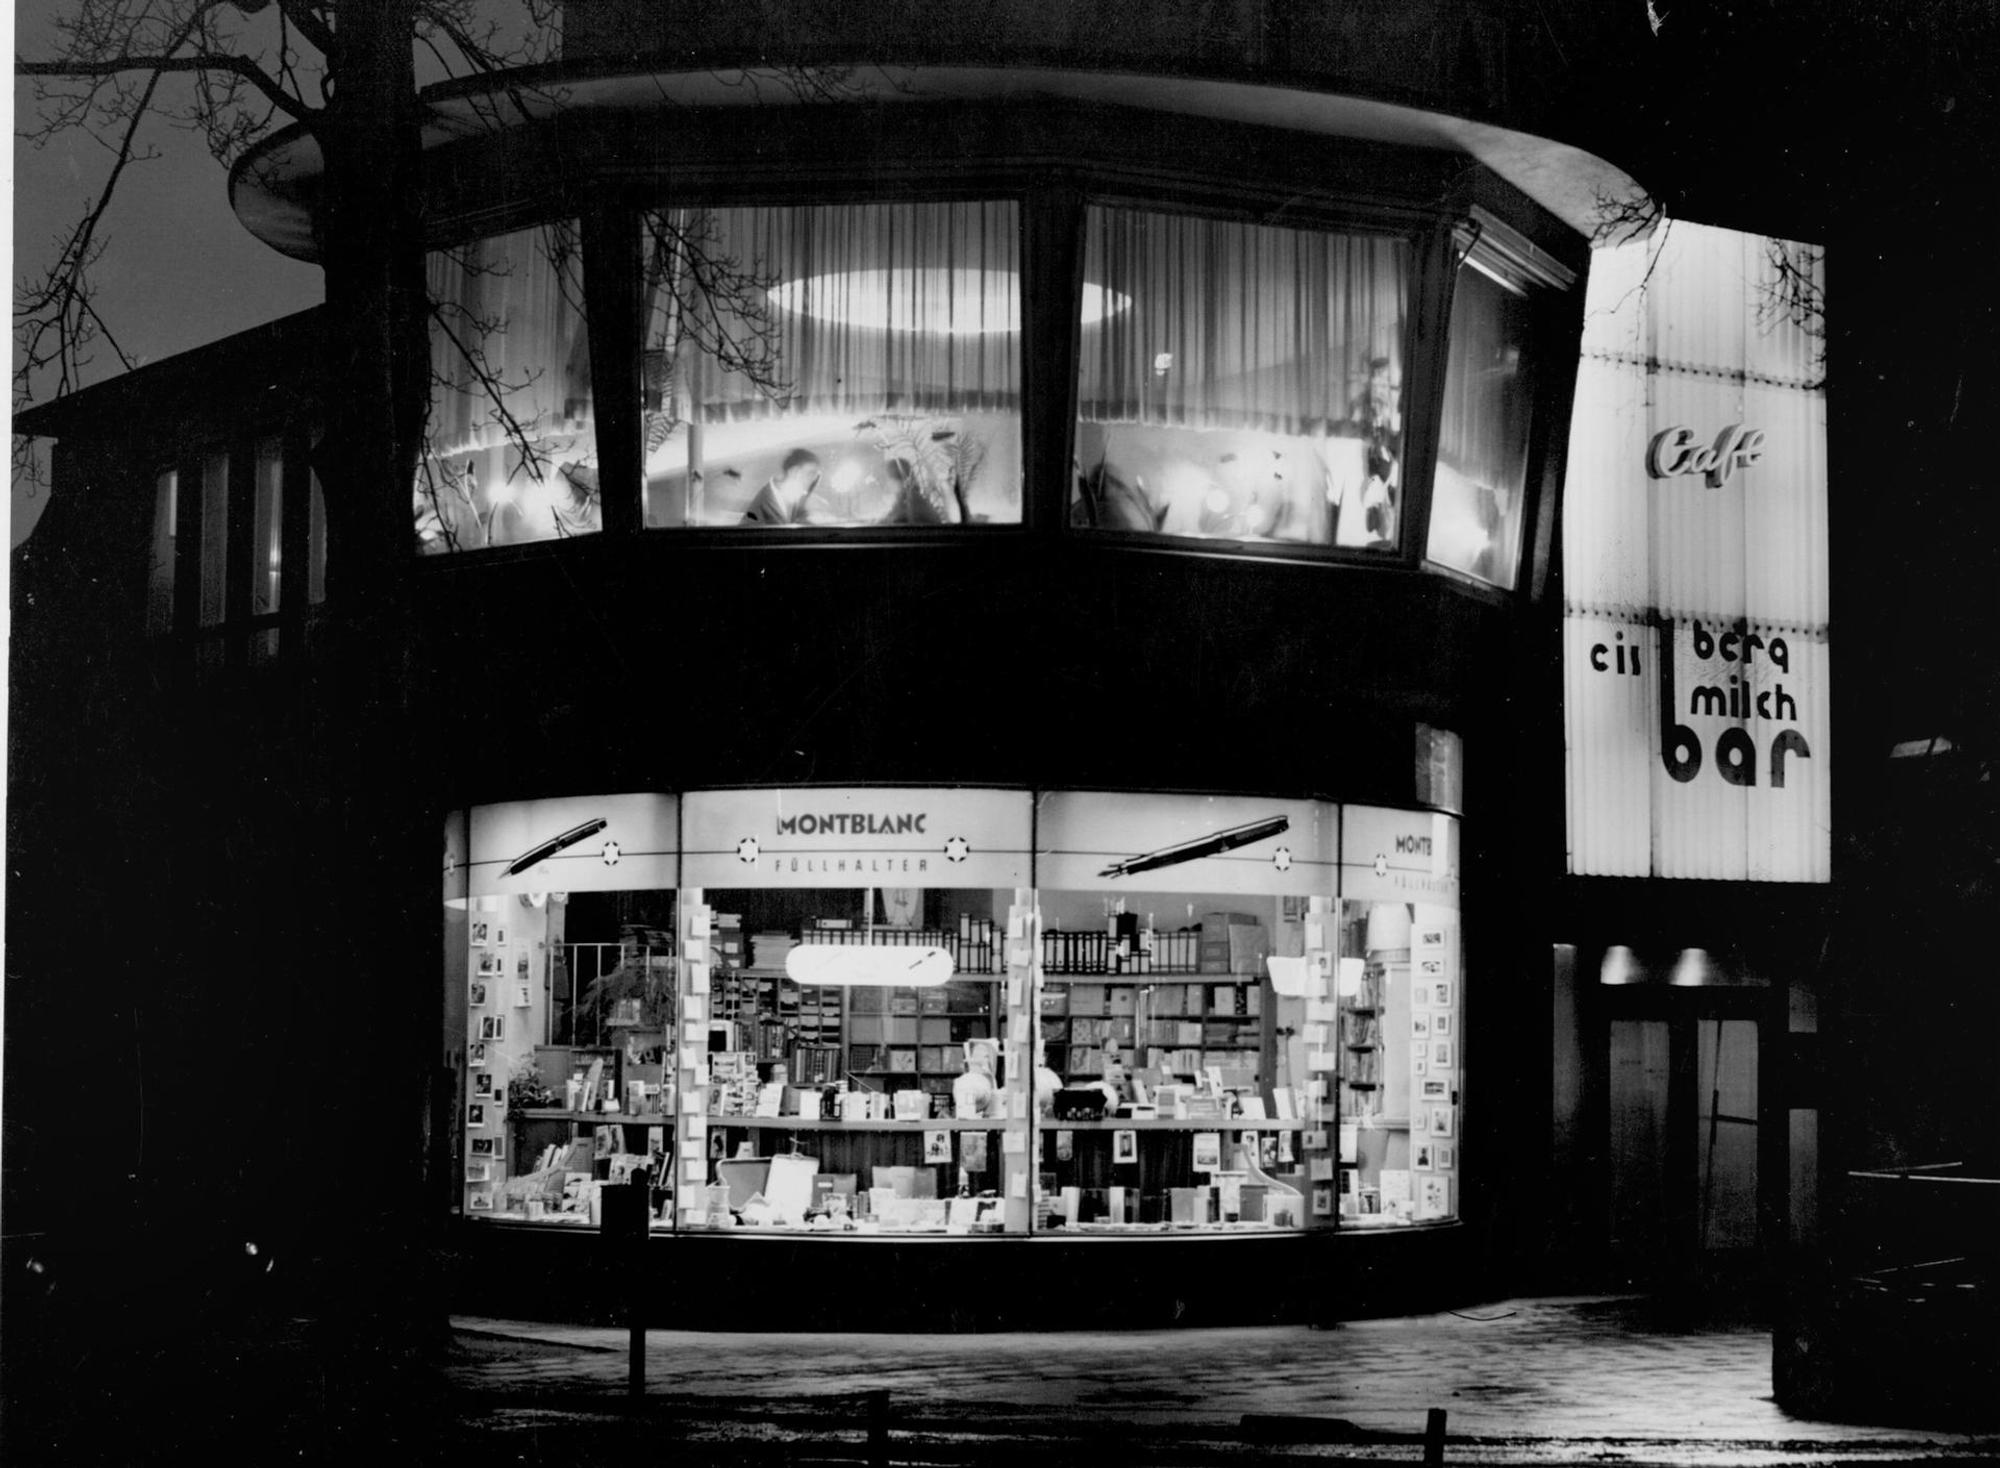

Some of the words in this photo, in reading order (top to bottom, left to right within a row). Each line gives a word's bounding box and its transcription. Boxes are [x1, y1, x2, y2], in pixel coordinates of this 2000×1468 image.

[1660, 618, 1811, 787] bar
[1691, 674, 1797, 721] milch
[777, 813, 926, 835] MONTBLANC
[775, 857, 927, 872] FÜLLHALTER
